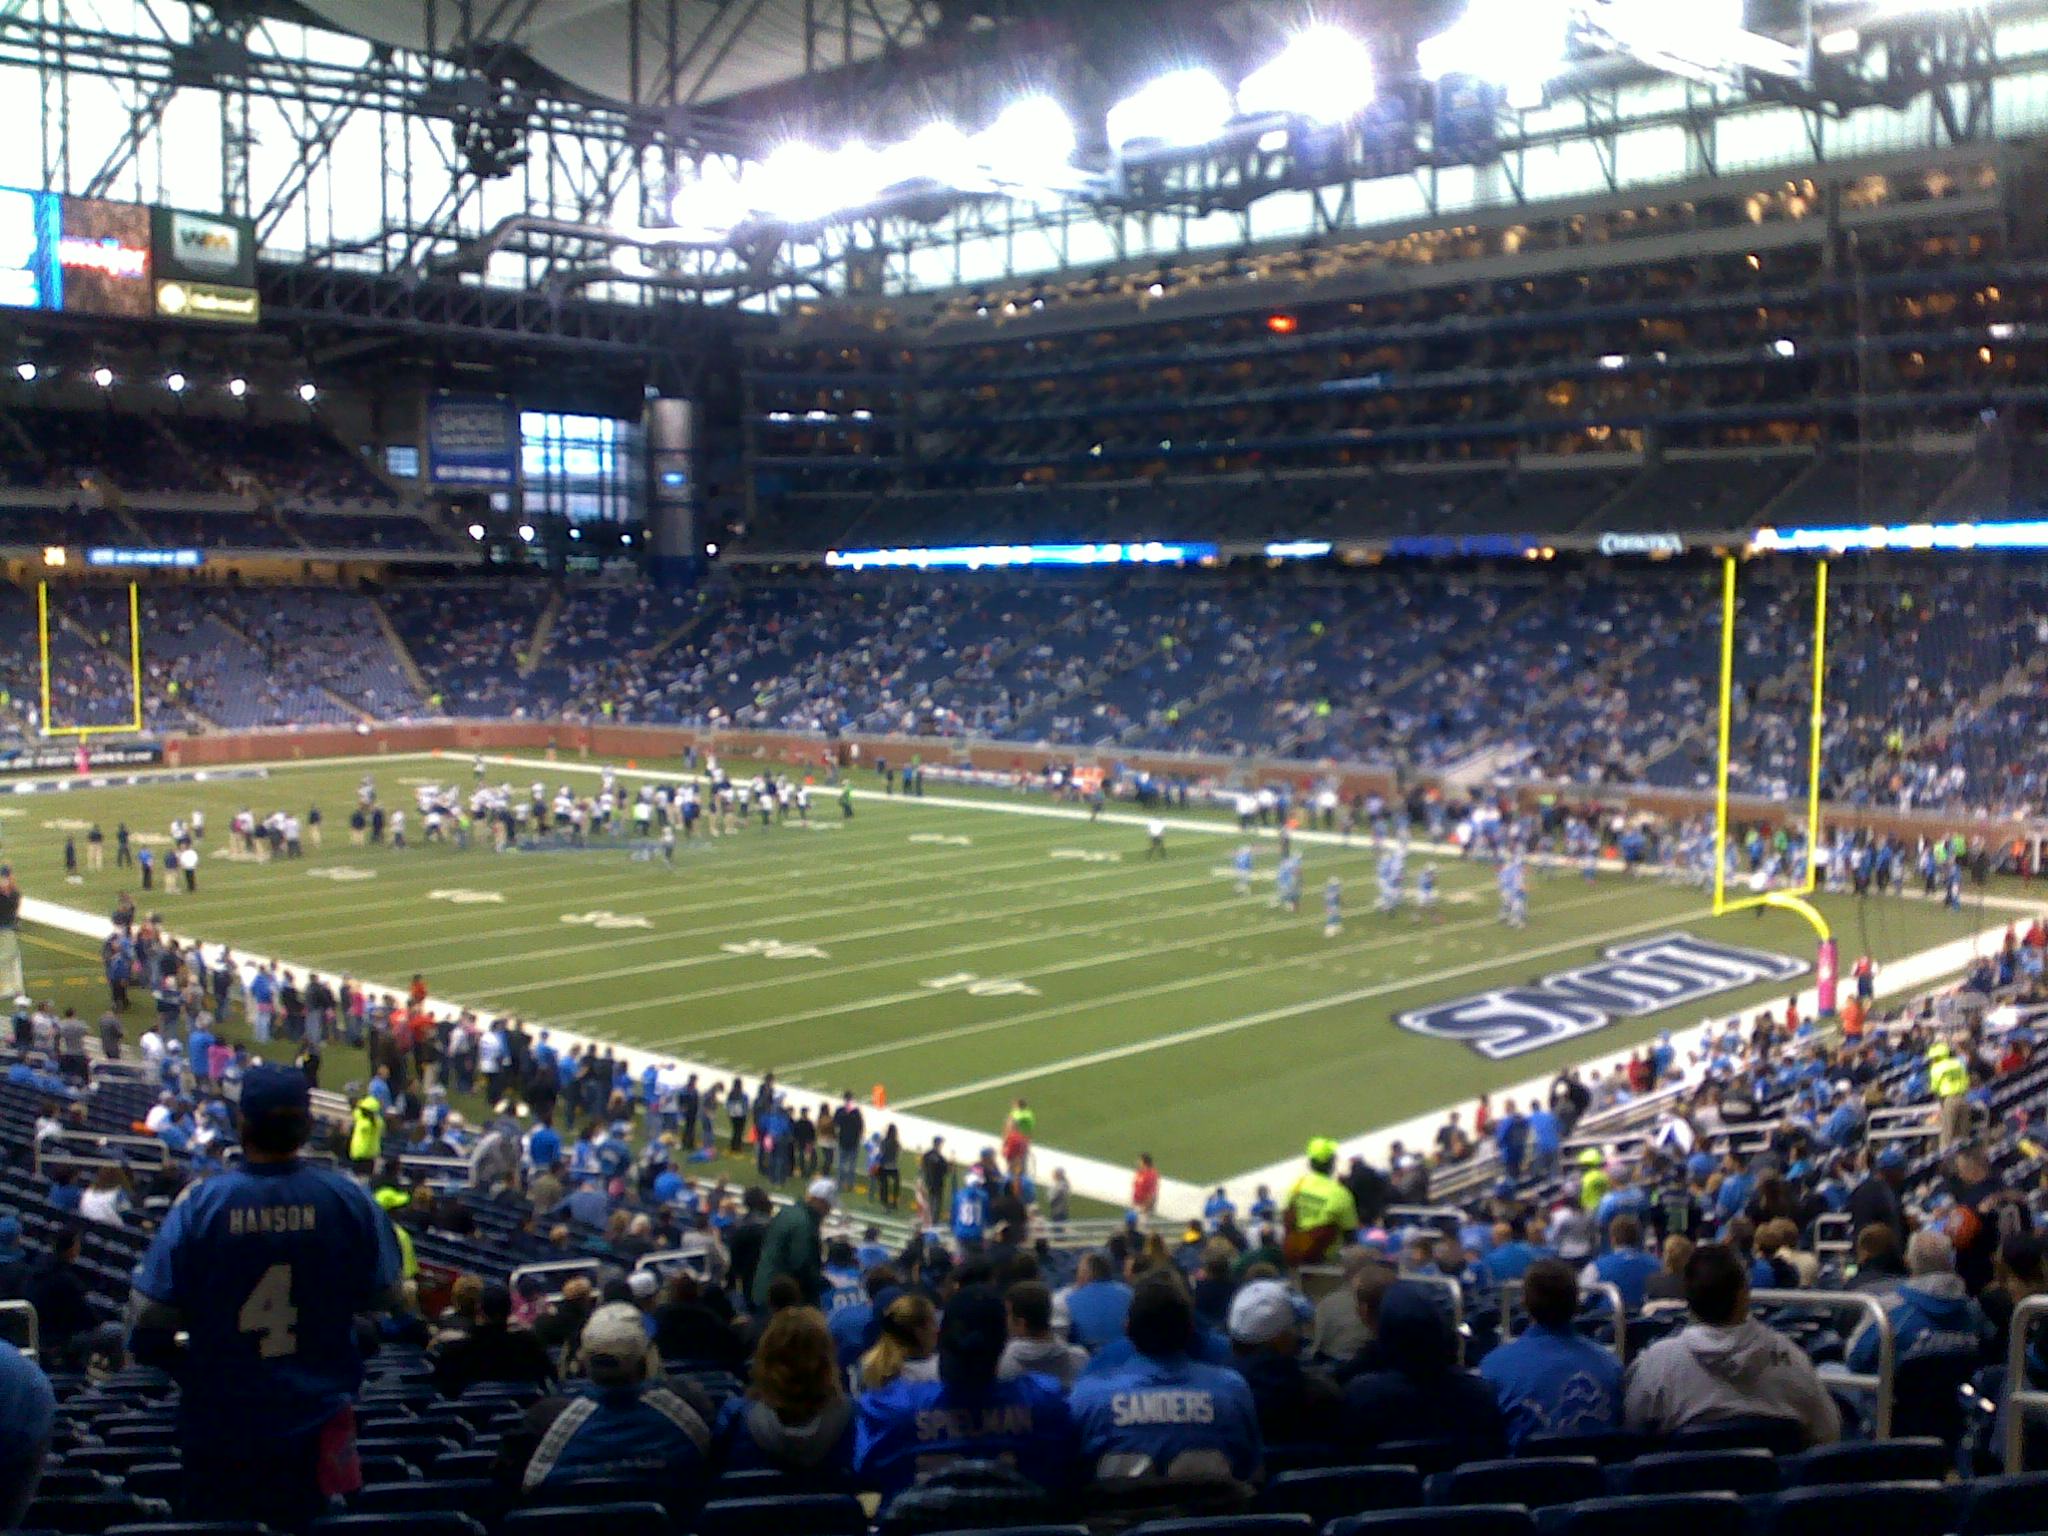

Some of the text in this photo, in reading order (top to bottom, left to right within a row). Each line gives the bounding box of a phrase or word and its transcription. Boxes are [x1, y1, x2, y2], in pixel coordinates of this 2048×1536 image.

[1396, 931, 1812, 1059] LIONS
[229, 1204, 316, 1234] HANSON
[238, 1264, 299, 1359] 4
[915, 1403, 1034, 1441] SPIELMAN
[1111, 1390, 1215, 1427] SANDERS
